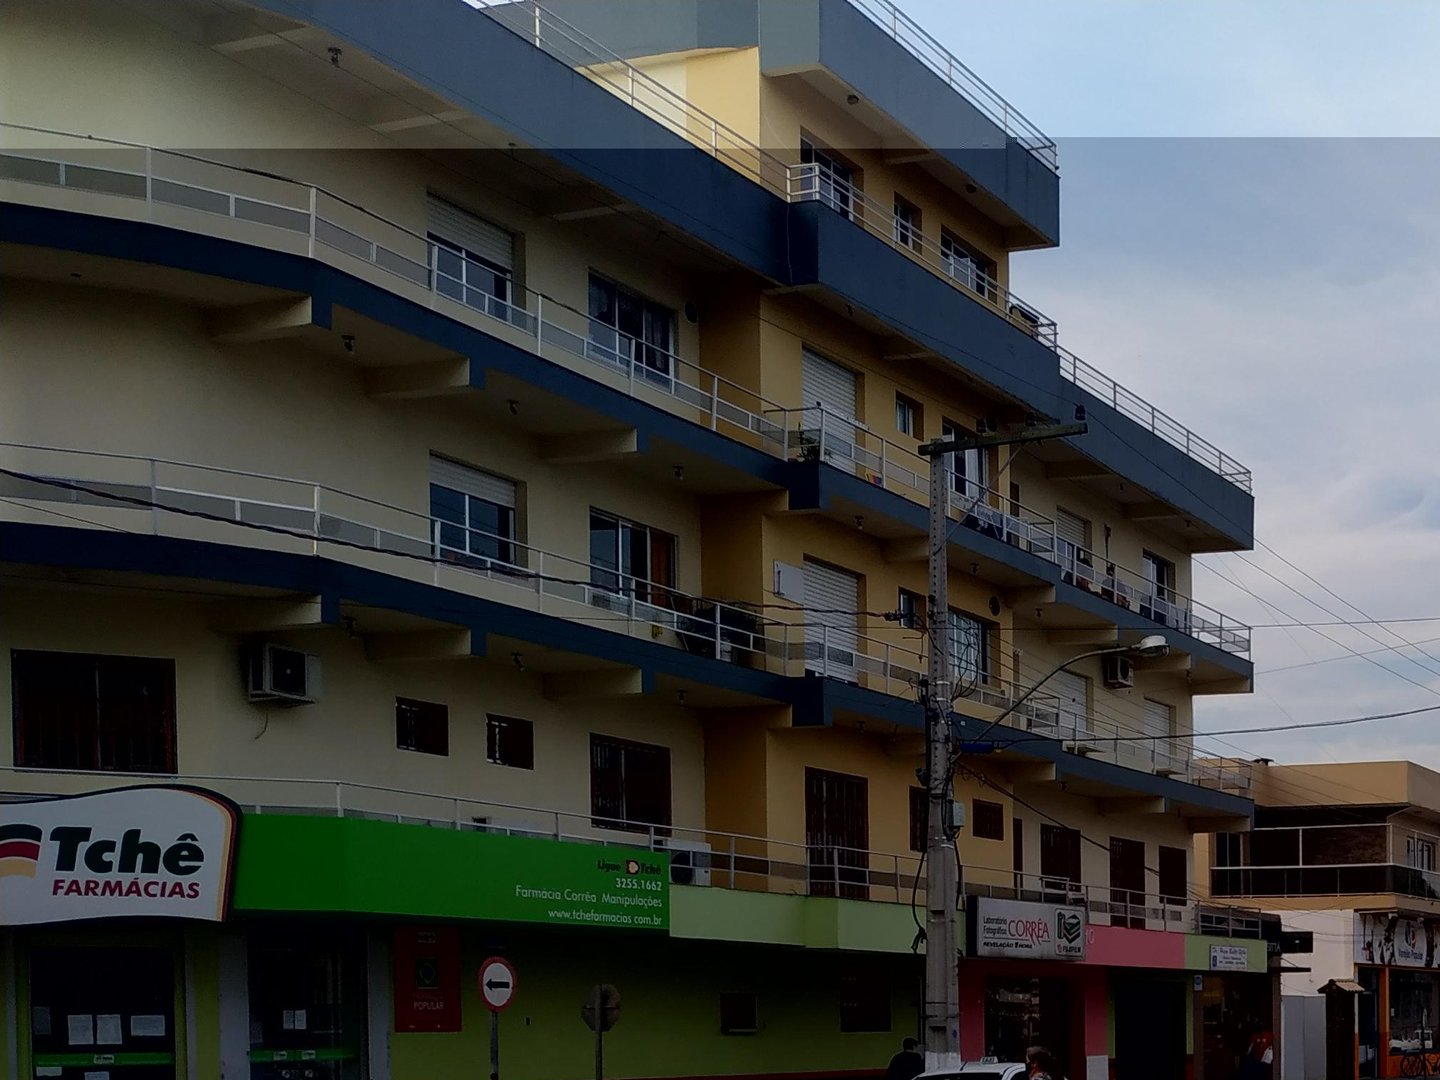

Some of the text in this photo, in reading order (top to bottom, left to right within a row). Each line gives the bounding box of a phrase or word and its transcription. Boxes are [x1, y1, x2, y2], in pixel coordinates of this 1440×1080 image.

[50, 826, 204, 876] Tchê
[52, 877, 200, 899] FARMÁCIAS
[515, 884, 561, 901] Farmácia
[602, 892, 663, 909] Manipulações
[615, 877, 662, 891] 3255.1662
[1008, 917, 1050, 945] CORRÊA
